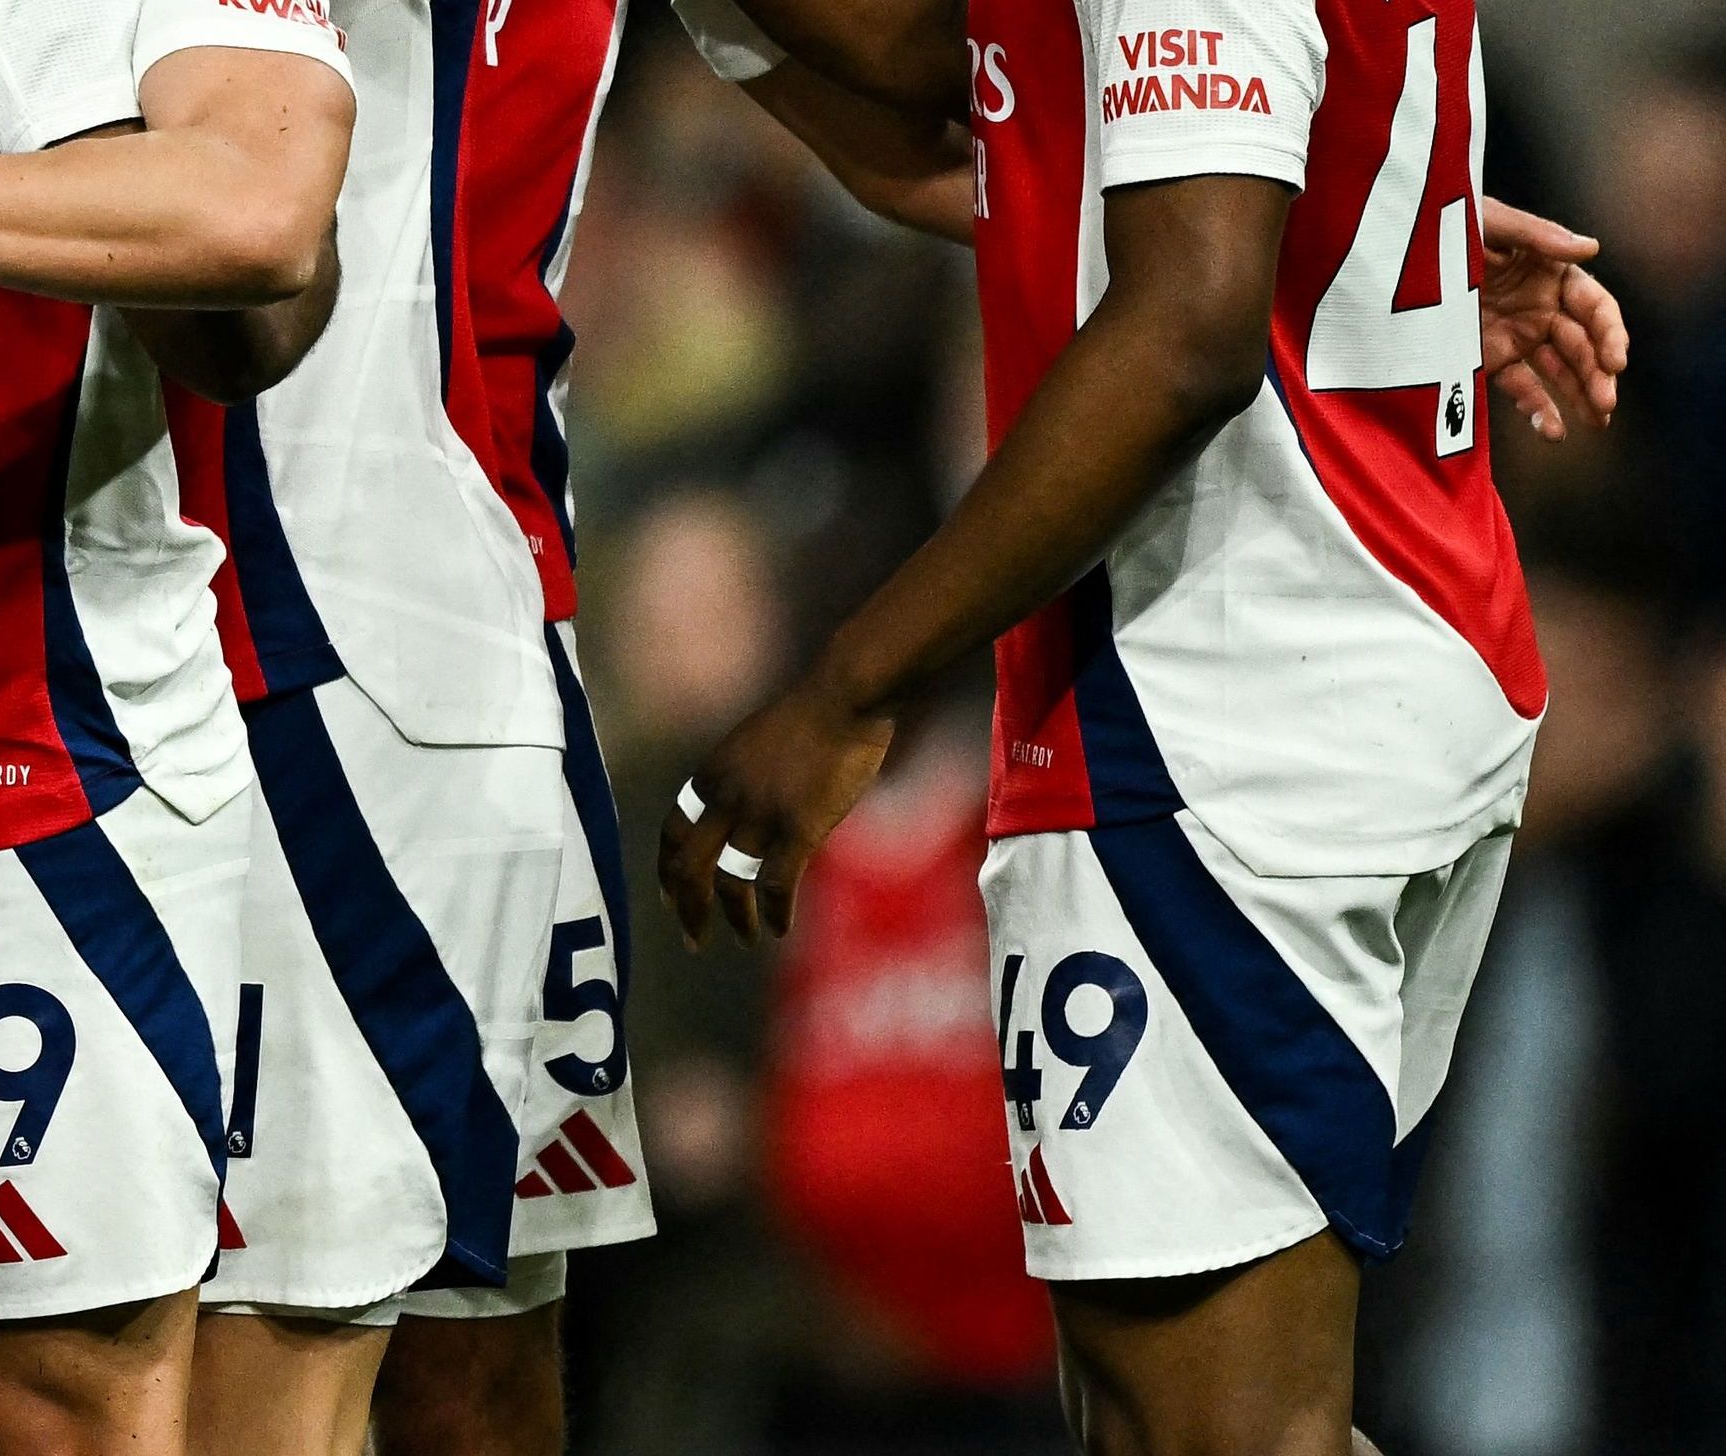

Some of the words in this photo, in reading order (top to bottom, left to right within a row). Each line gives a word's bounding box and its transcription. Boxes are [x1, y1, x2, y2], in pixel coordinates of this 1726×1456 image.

[1102, 74, 1272, 124] RWANDA
[1118, 29, 1223, 70] VISIT
[1305, 13, 1486, 458] 4
[999, 951, 1148, 1131] 49
